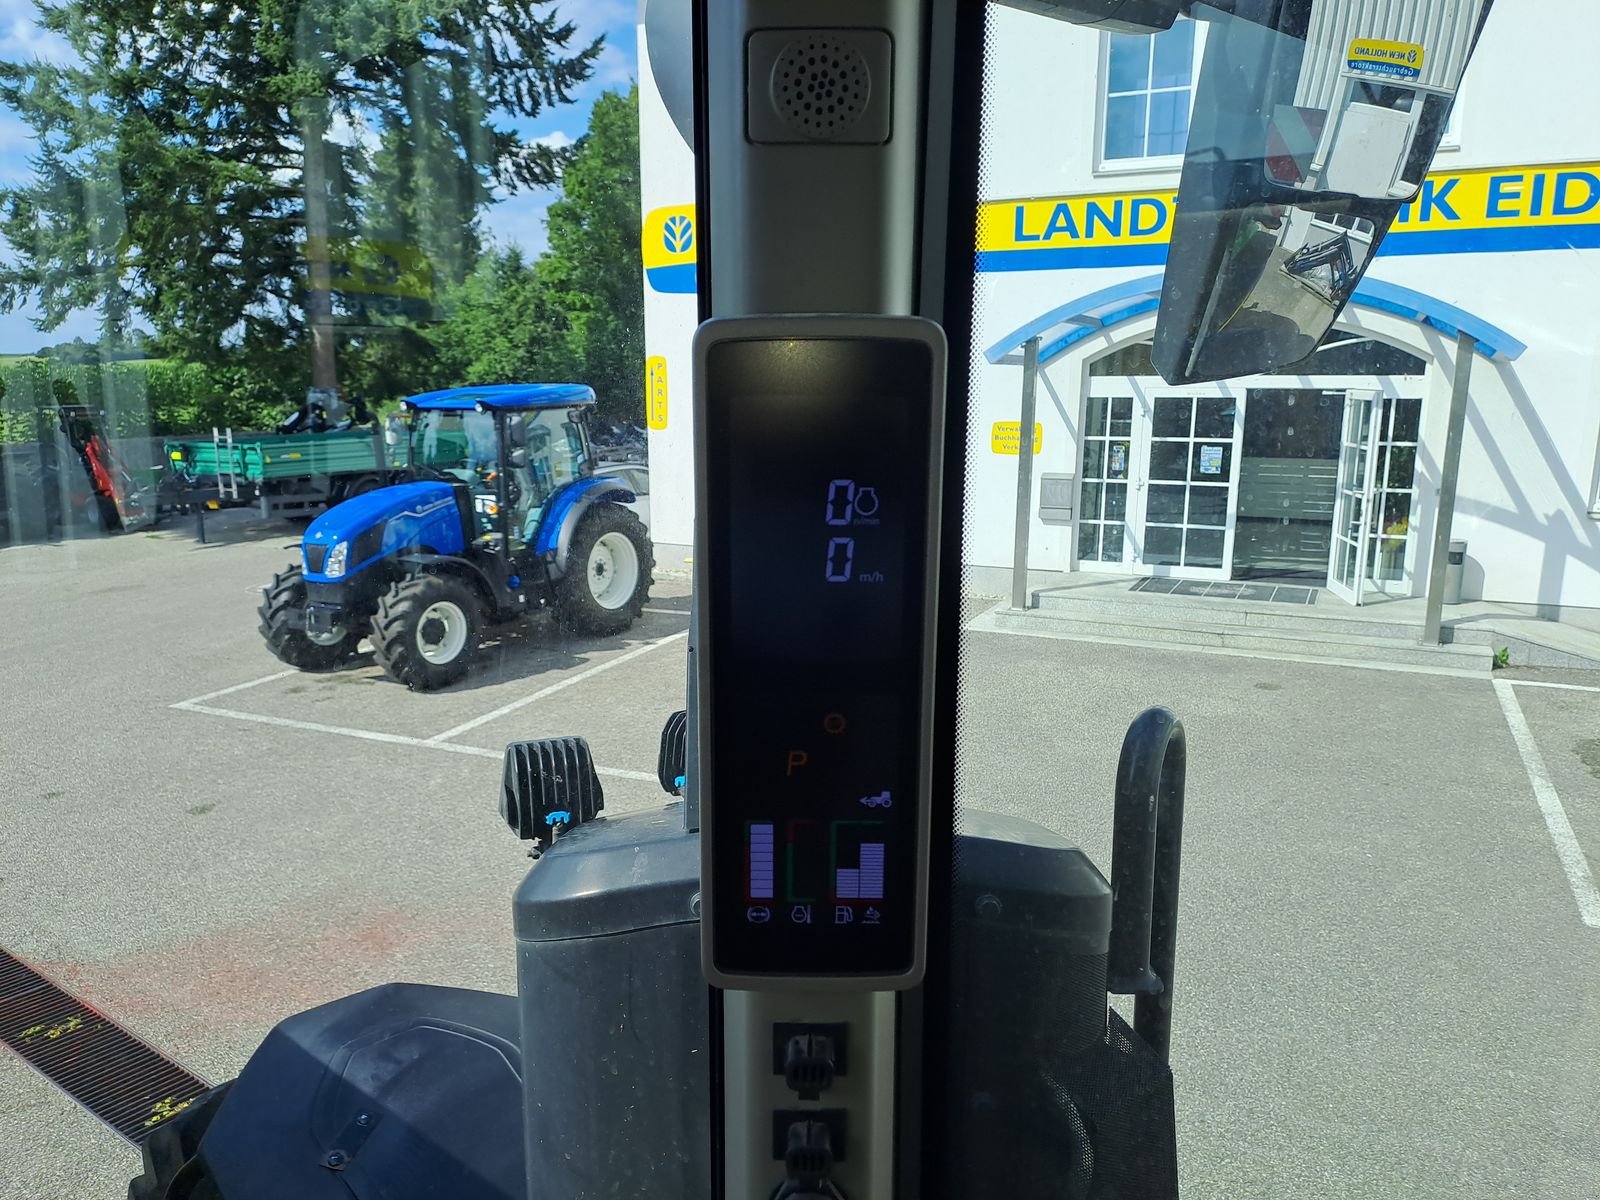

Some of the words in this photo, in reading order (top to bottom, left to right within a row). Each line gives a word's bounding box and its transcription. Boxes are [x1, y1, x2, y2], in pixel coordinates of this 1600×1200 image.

[1014, 196, 1178, 242] LAND
[656, 362, 664, 422] PARTS
[825, 479, 855, 526] 0
[825, 537, 855, 582] 0
[787, 750, 808, 776] P
